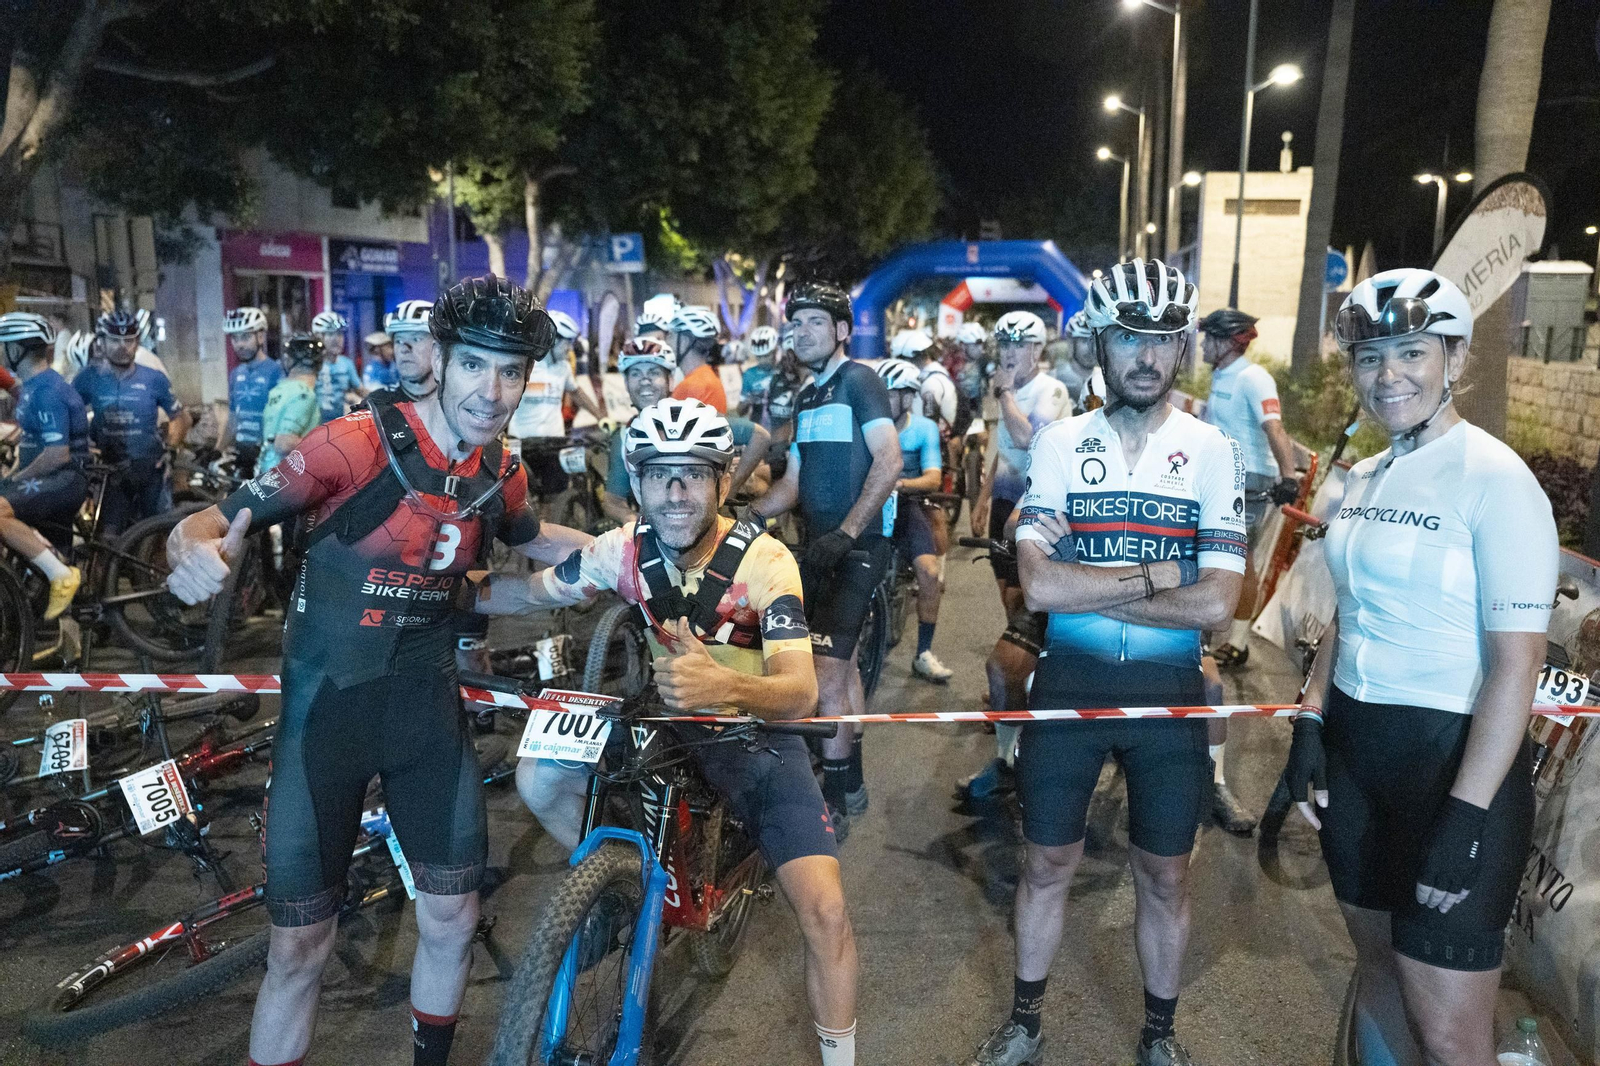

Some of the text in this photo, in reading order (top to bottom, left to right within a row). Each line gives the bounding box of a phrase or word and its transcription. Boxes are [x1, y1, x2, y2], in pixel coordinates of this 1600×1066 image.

[612, 235, 634, 261] P
[391, 431, 405, 439] XC
[1230, 441, 1241, 491] SEGUROS
[1072, 497, 1188, 523] BIKESTORE
[1336, 506, 1441, 532] TOP4CYCLING
[1075, 536, 1181, 560] ALMERÍA
[300, 558, 308, 597] TOLDOS
[367, 567, 455, 589] ESPEJO
[555, 694, 566, 702] LA
[542, 711, 610, 740] 7007
[51, 731, 70, 769] 6709
[543, 742, 582, 755] cajamar
[142, 776, 177, 823] 7005
